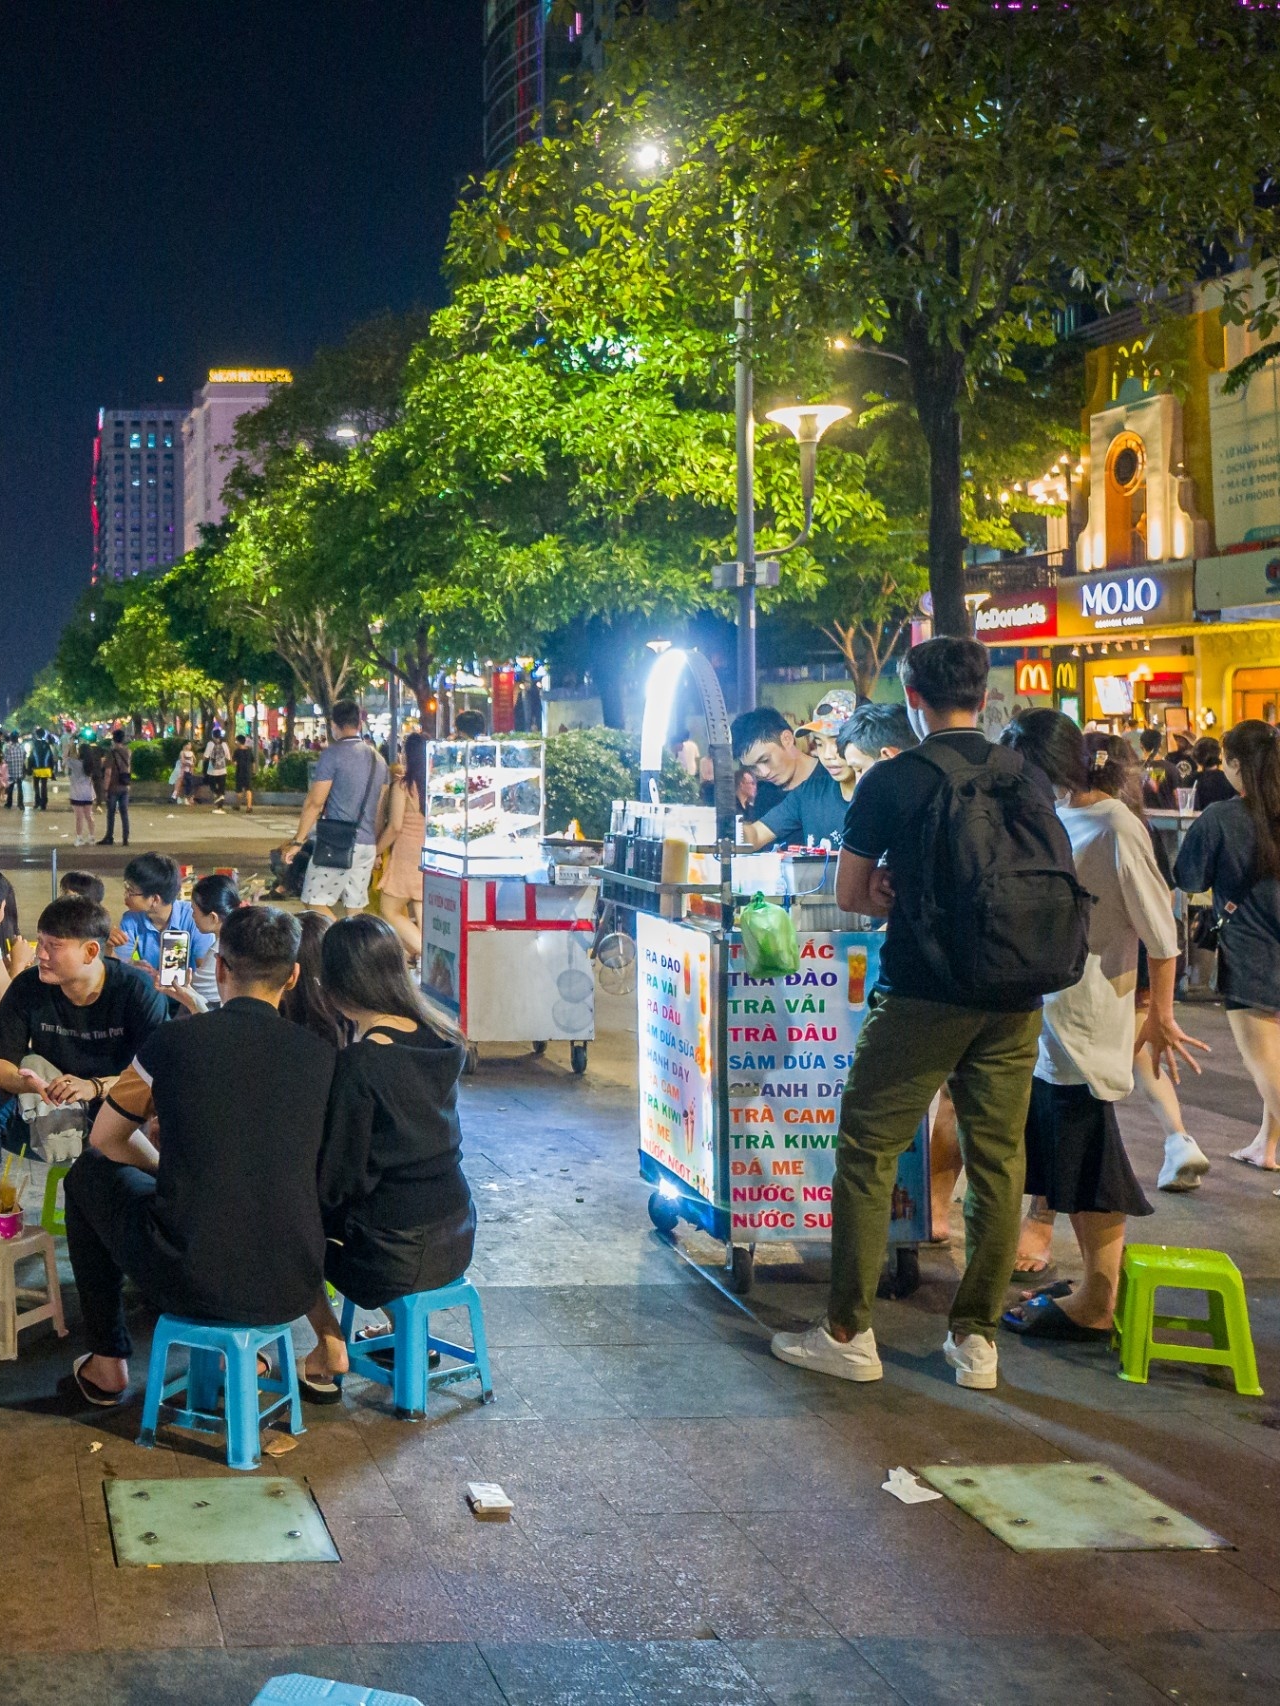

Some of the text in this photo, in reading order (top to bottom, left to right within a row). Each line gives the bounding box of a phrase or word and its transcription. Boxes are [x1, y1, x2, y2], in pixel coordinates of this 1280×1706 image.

[1082, 577, 1157, 617] MOJO
[799, 938, 835, 959] ẮC
[785, 968, 838, 987] ĐÀO
[728, 993, 825, 1014] TRÀ VẢI
[661, 1004, 681, 1027] DÂU
[728, 1023, 838, 1043] TRÀ DÂU
[729, 1051, 776, 1070] SÂM
[783, 1051, 826, 1070] DỨA
[661, 1079, 680, 1102] CAM
[817, 1079, 847, 1098] DÂ
[662, 1101, 682, 1128] KIWI
[730, 1105, 836, 1124] TRÀ CAM
[656, 1122, 672, 1144] ME
[730, 1130, 839, 1150] TRÀ KIWI
[731, 1157, 805, 1176] ĐÁ ME
[732, 1183, 832, 1202] NƯỚC NG
[732, 1209, 832, 1229] NƯỚC SU
